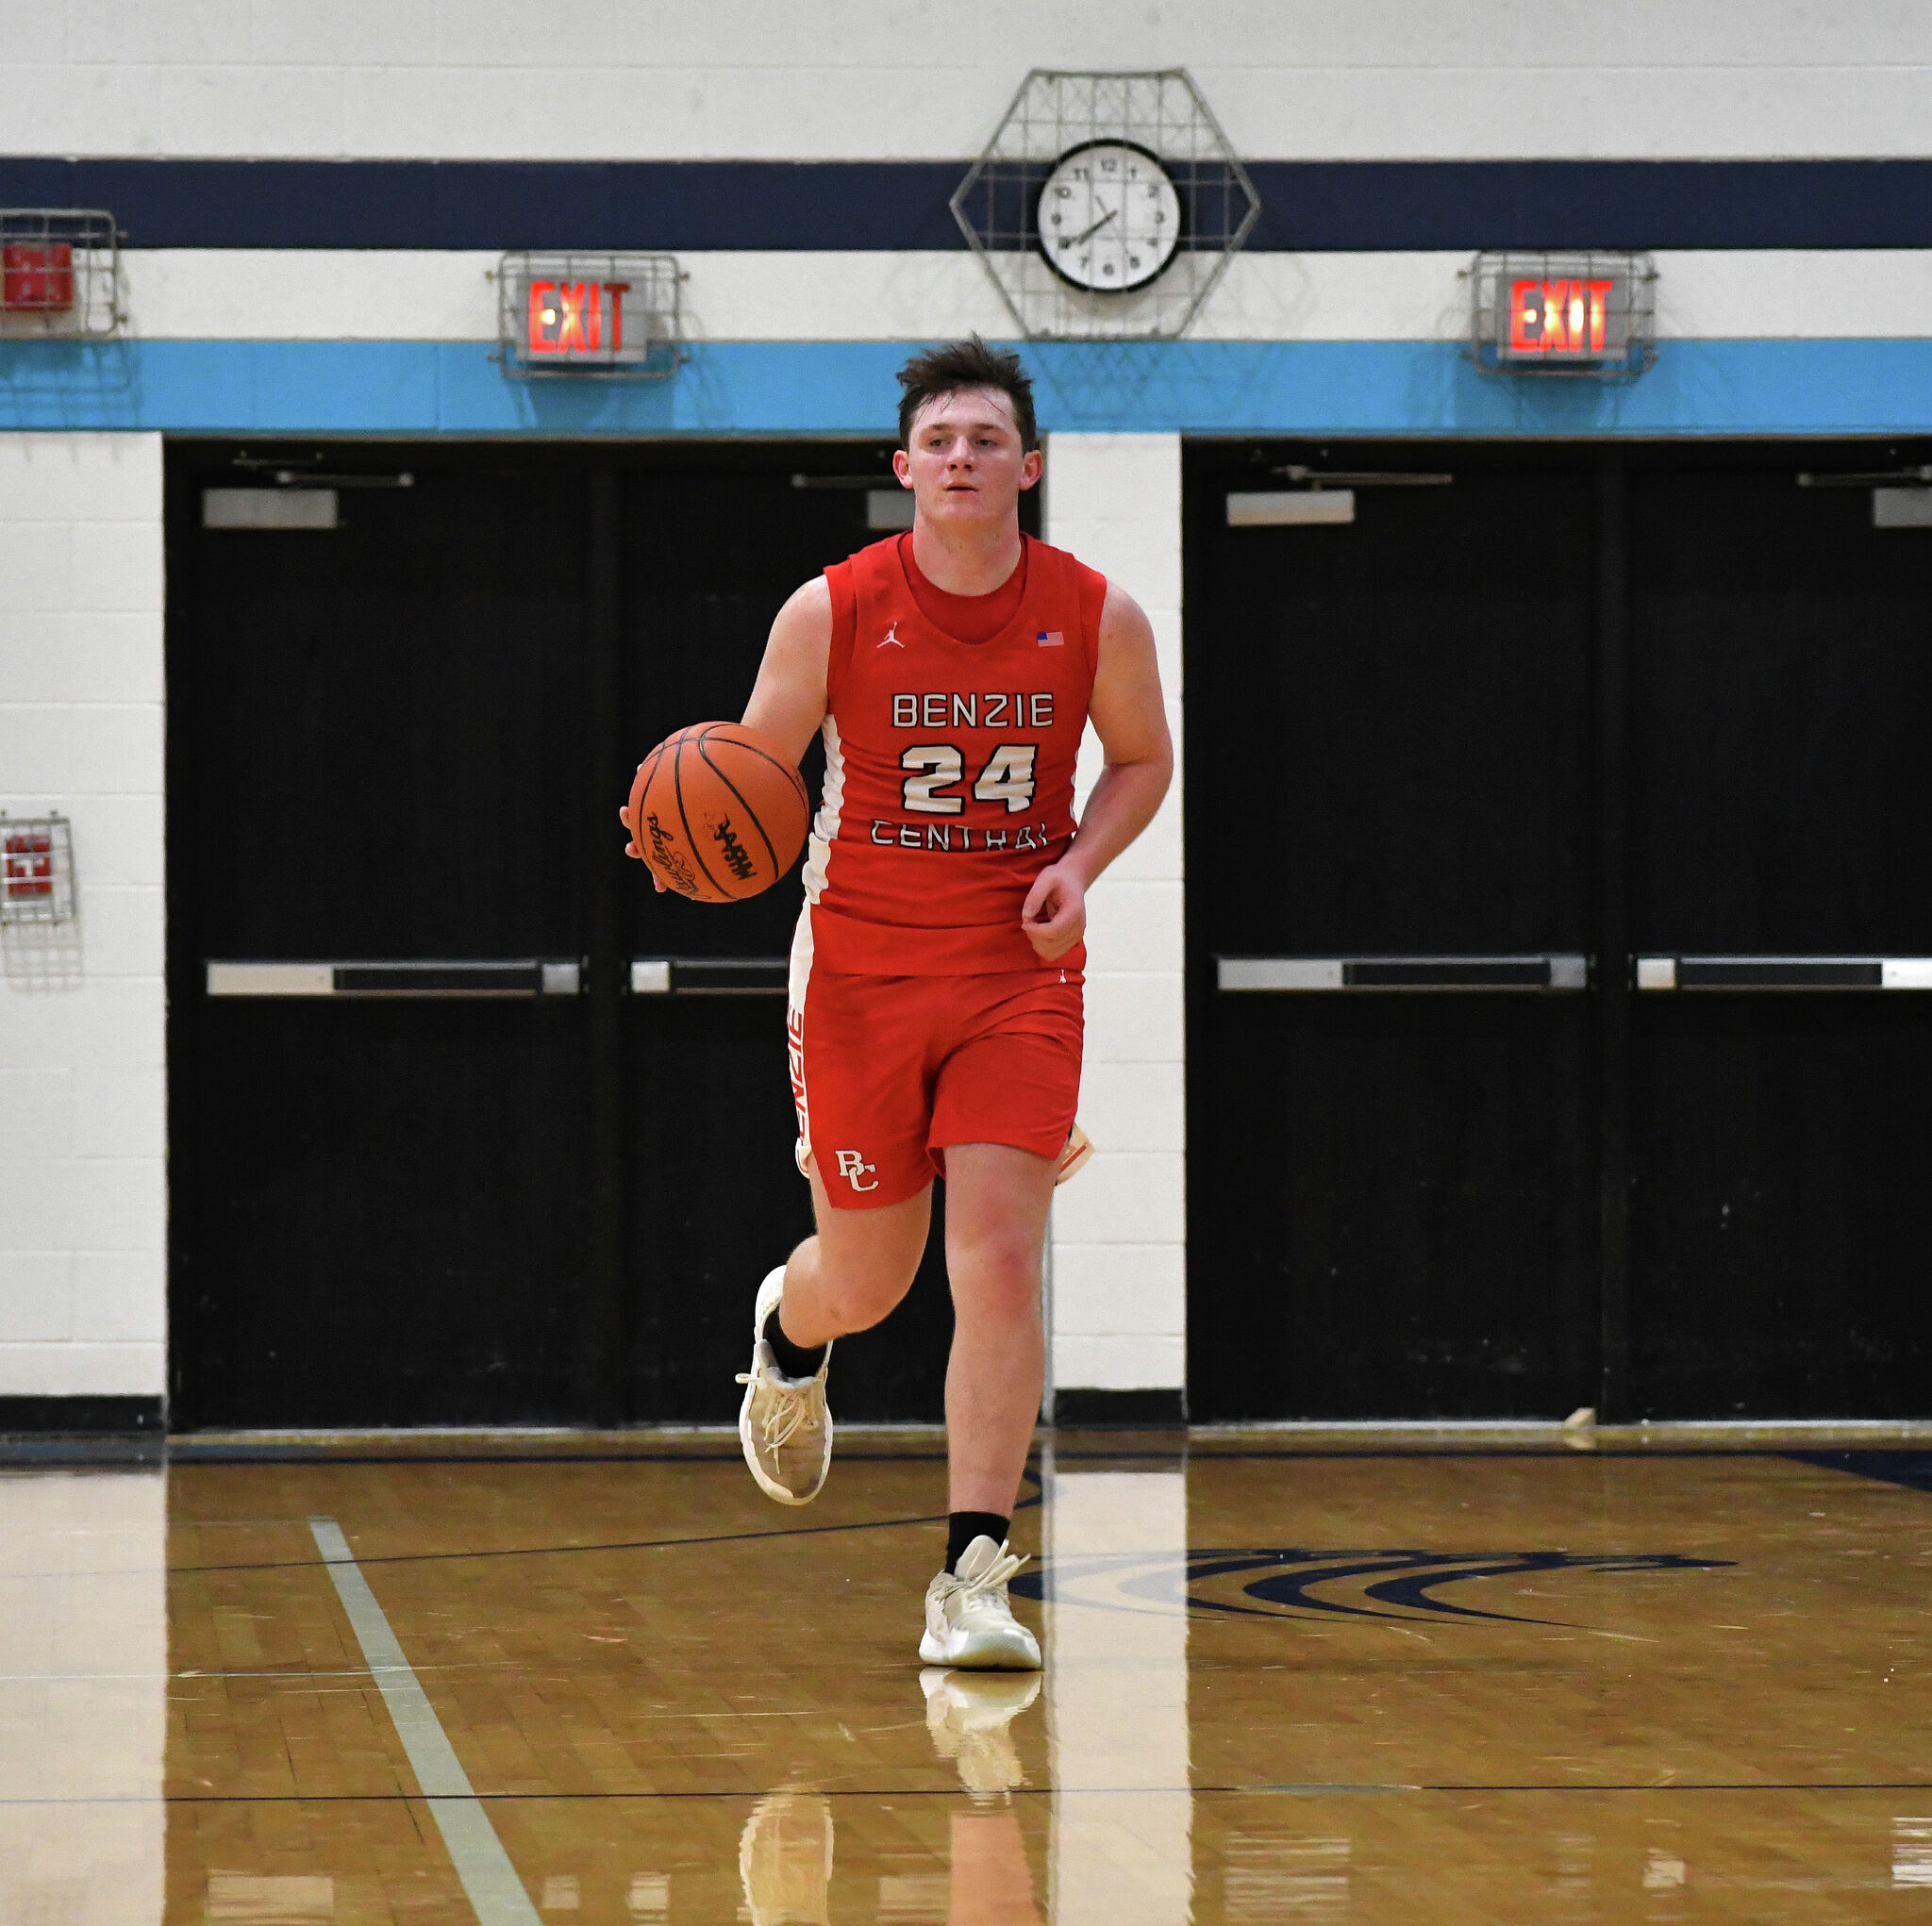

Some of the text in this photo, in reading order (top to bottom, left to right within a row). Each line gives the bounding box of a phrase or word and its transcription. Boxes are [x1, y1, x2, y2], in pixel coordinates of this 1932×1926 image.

[528, 281, 630, 353] EXIT
[1510, 279, 1613, 352] EXIT
[891, 692, 1054, 728] BENZIE
[899, 743, 1039, 816] 24
[835, 1150, 879, 1192] BC
